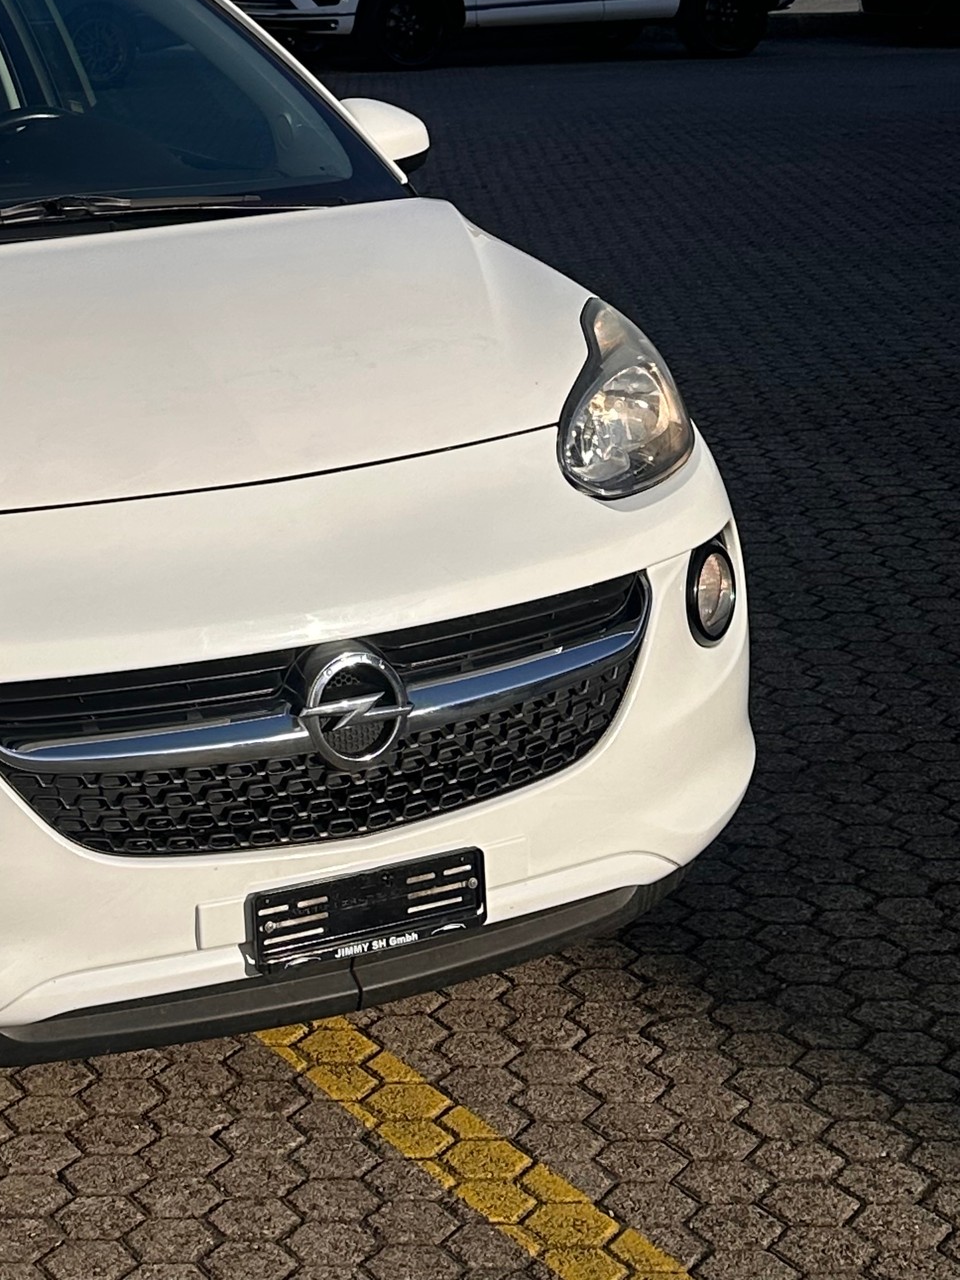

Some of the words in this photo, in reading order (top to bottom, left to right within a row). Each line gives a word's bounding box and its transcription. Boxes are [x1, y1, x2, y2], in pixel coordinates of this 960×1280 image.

[335, 942, 369, 959] JIMMY
[372, 937, 387, 950] SH
[388, 932, 419, 947] Gmbh
